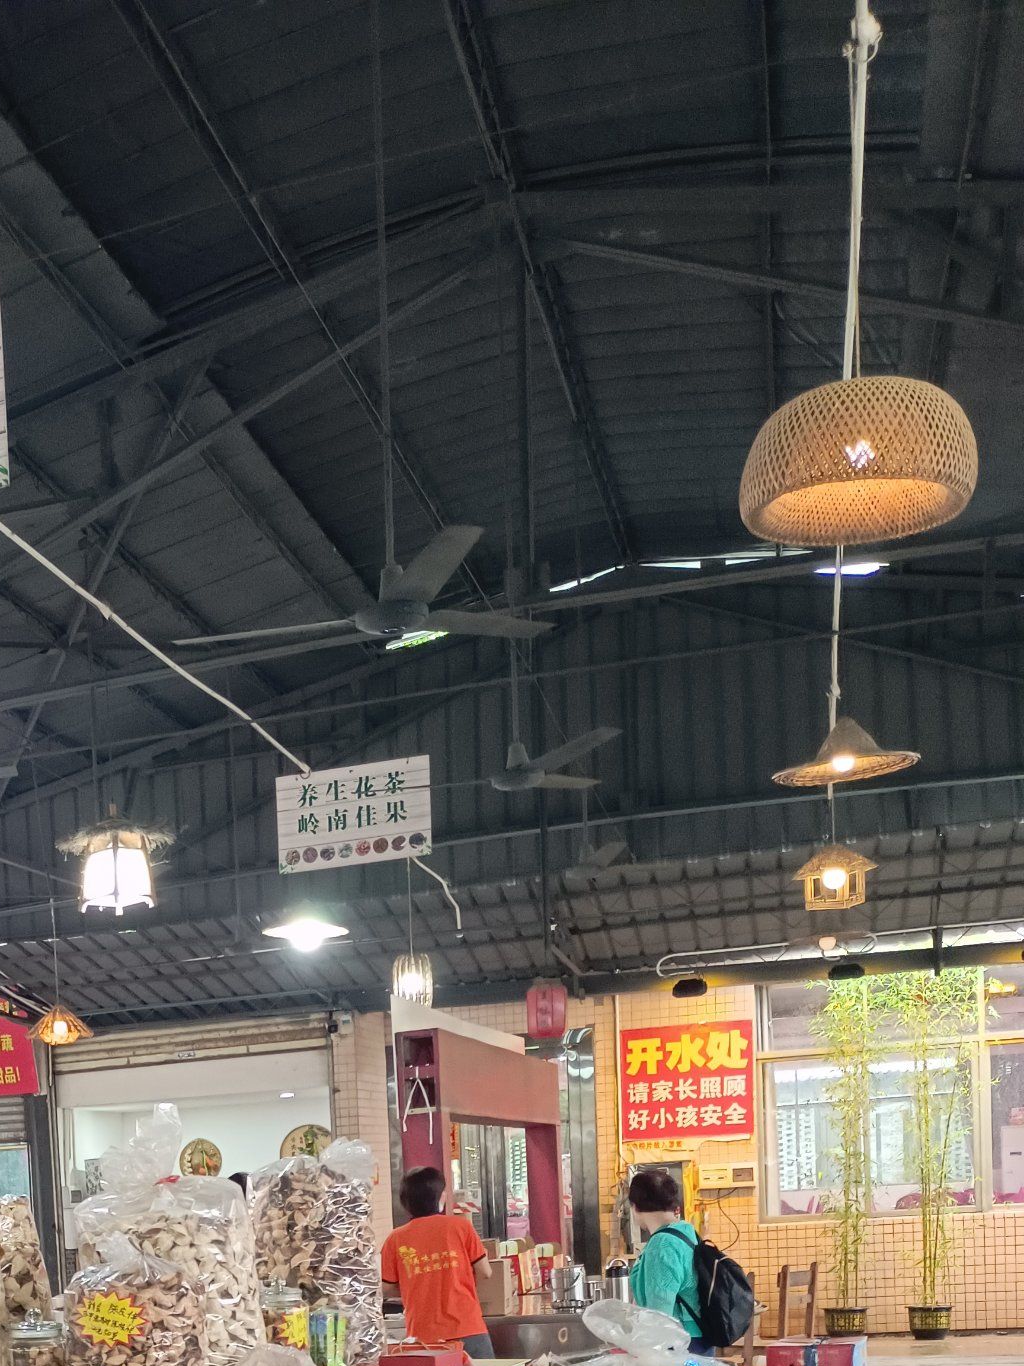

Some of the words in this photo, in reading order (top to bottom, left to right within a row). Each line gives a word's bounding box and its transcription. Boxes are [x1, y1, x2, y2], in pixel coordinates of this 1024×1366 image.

[298, 771, 406, 808] 养生花茶
[297, 800, 408, 835] 岭南佳果
[626, 1030, 749, 1076] 开水处
[627, 1075, 747, 1104] 请家长照顾
[628, 1102, 747, 1131] 好小孩安全
